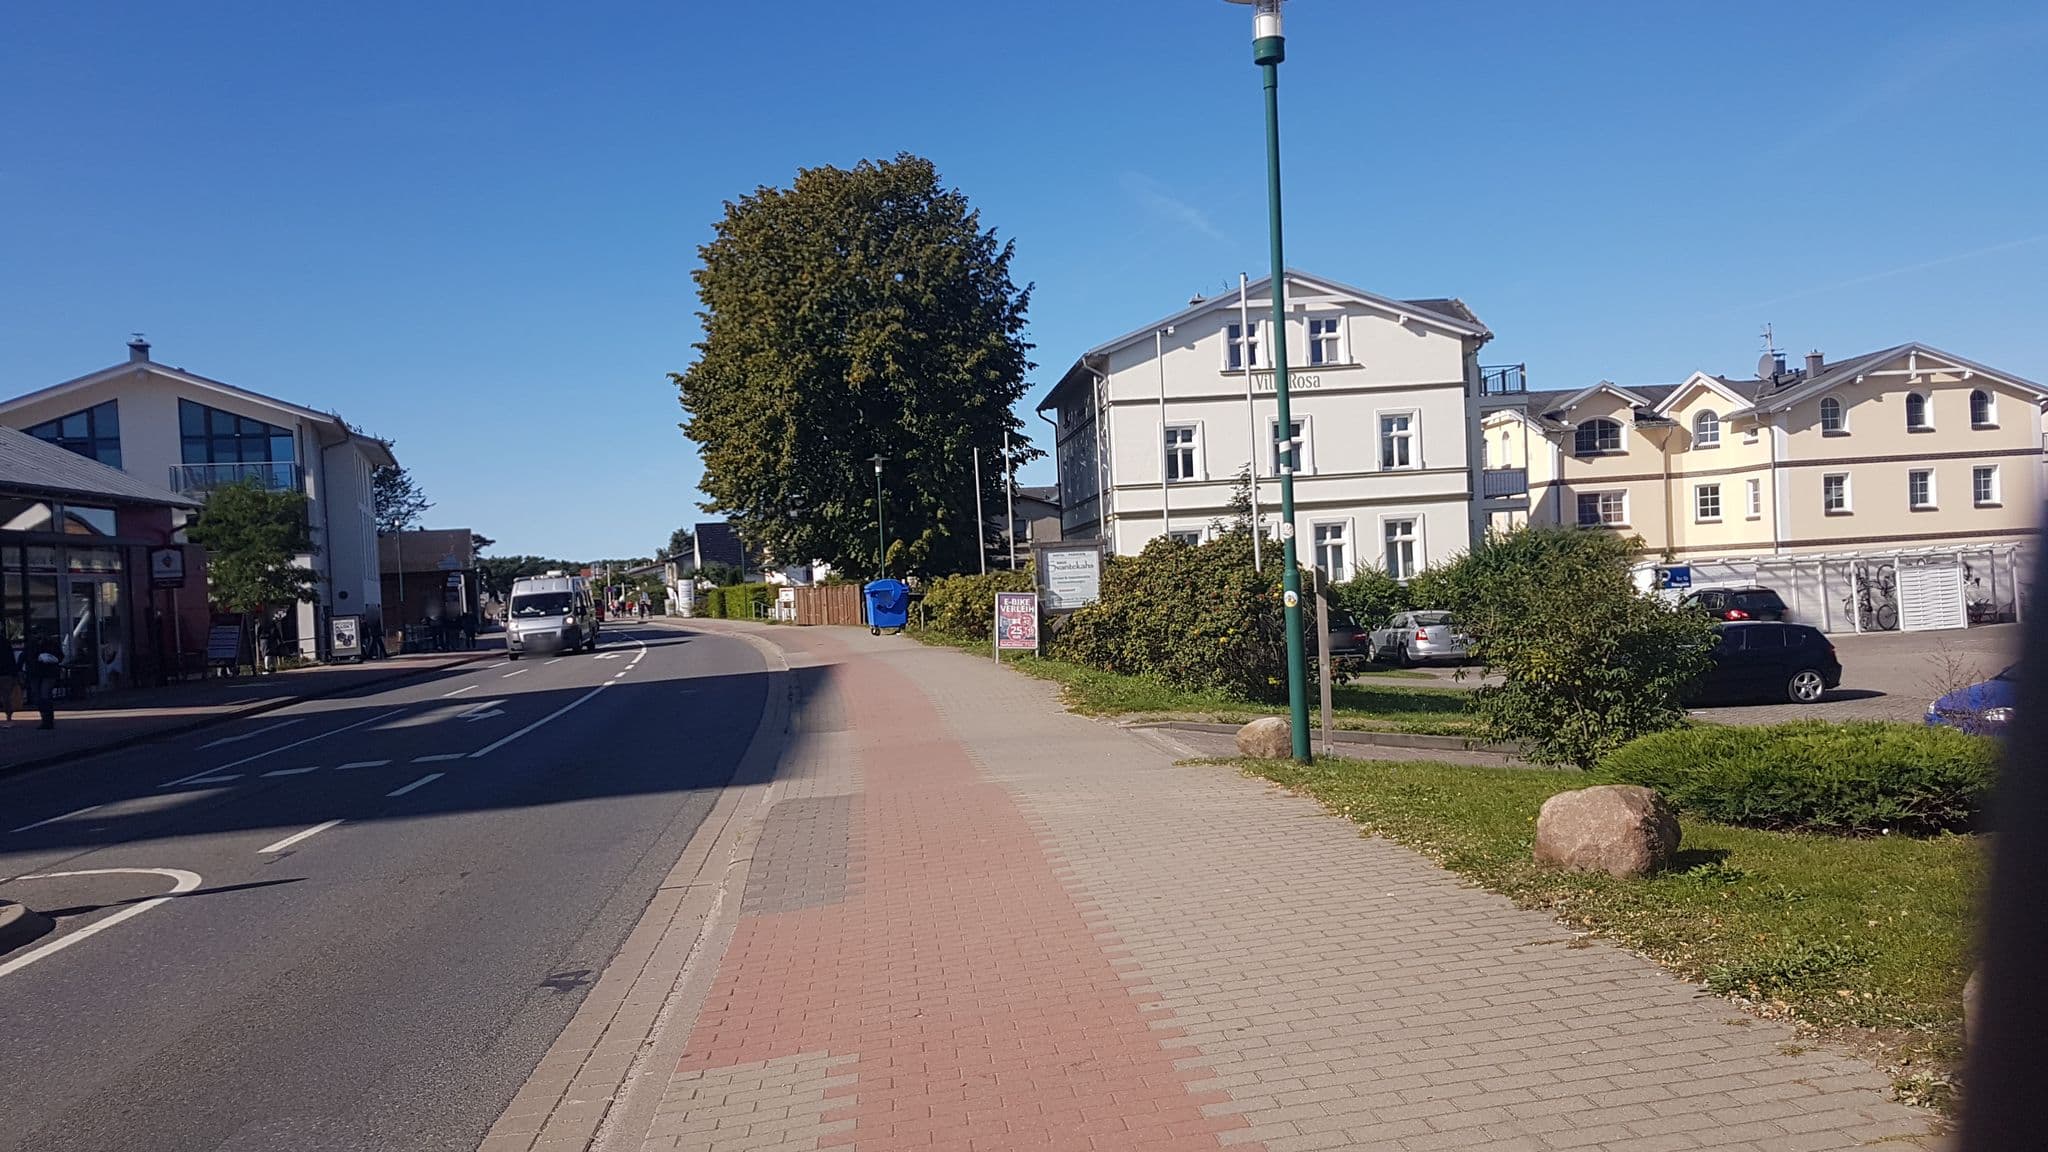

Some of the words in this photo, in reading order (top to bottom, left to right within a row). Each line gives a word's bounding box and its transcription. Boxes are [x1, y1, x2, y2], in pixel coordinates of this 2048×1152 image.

[1255, 374, 1278, 391] Vill
[1289, 373, 1321, 389] Rosa
[1004, 598, 1030, 606] E-BIKE
[1000, 605, 1034, 613] VERLEIH
[1010, 626, 1023, 635] 25
